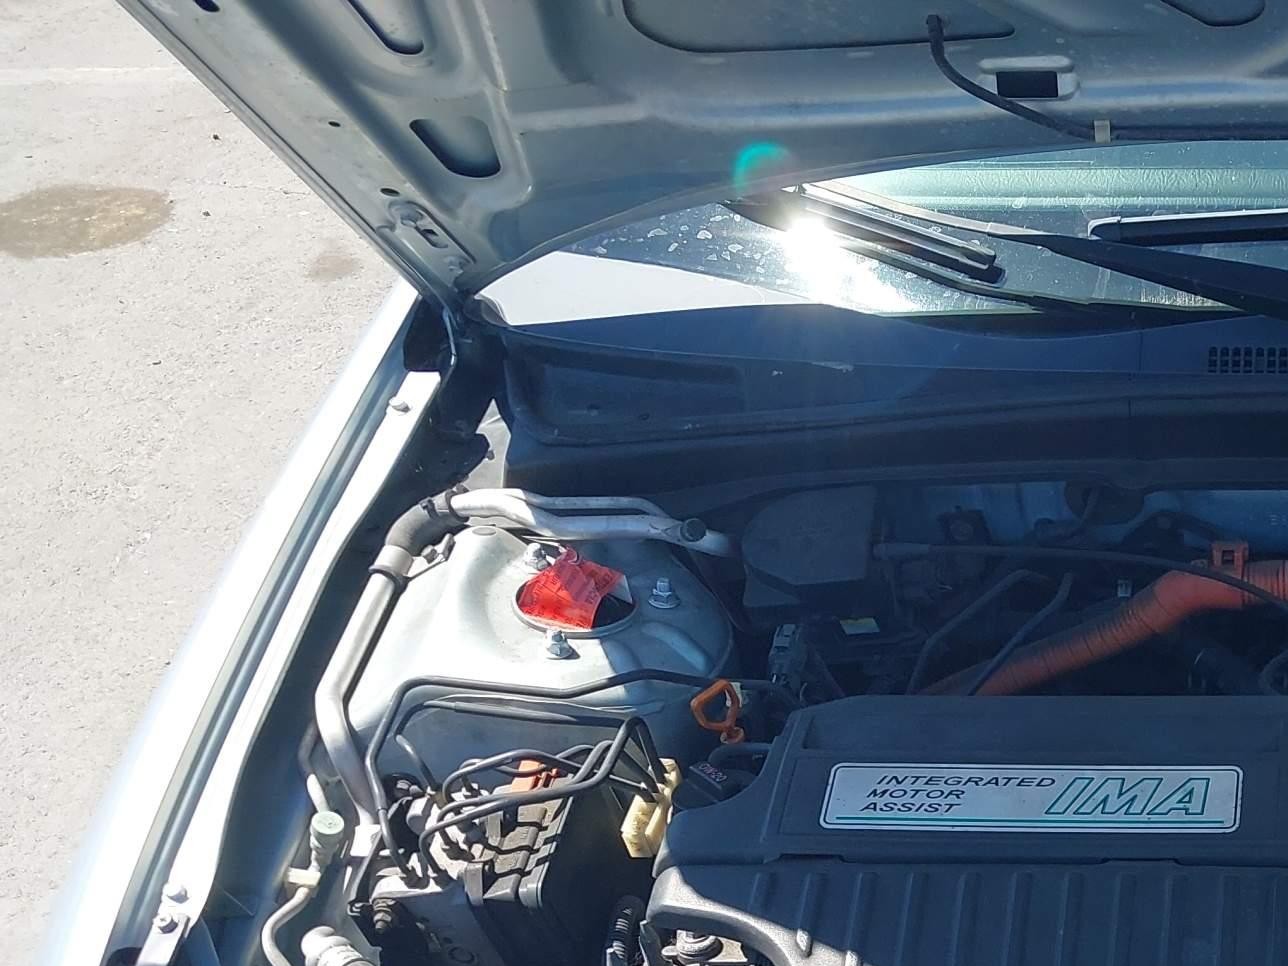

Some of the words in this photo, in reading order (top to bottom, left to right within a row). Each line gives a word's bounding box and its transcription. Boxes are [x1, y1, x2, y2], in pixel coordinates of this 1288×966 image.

[866, 789, 966, 800] MOTOR
[876, 775, 1056, 788] INTEGRATED
[1044, 776, 1211, 816] IMA
[859, 801, 961, 814] ASSIST
